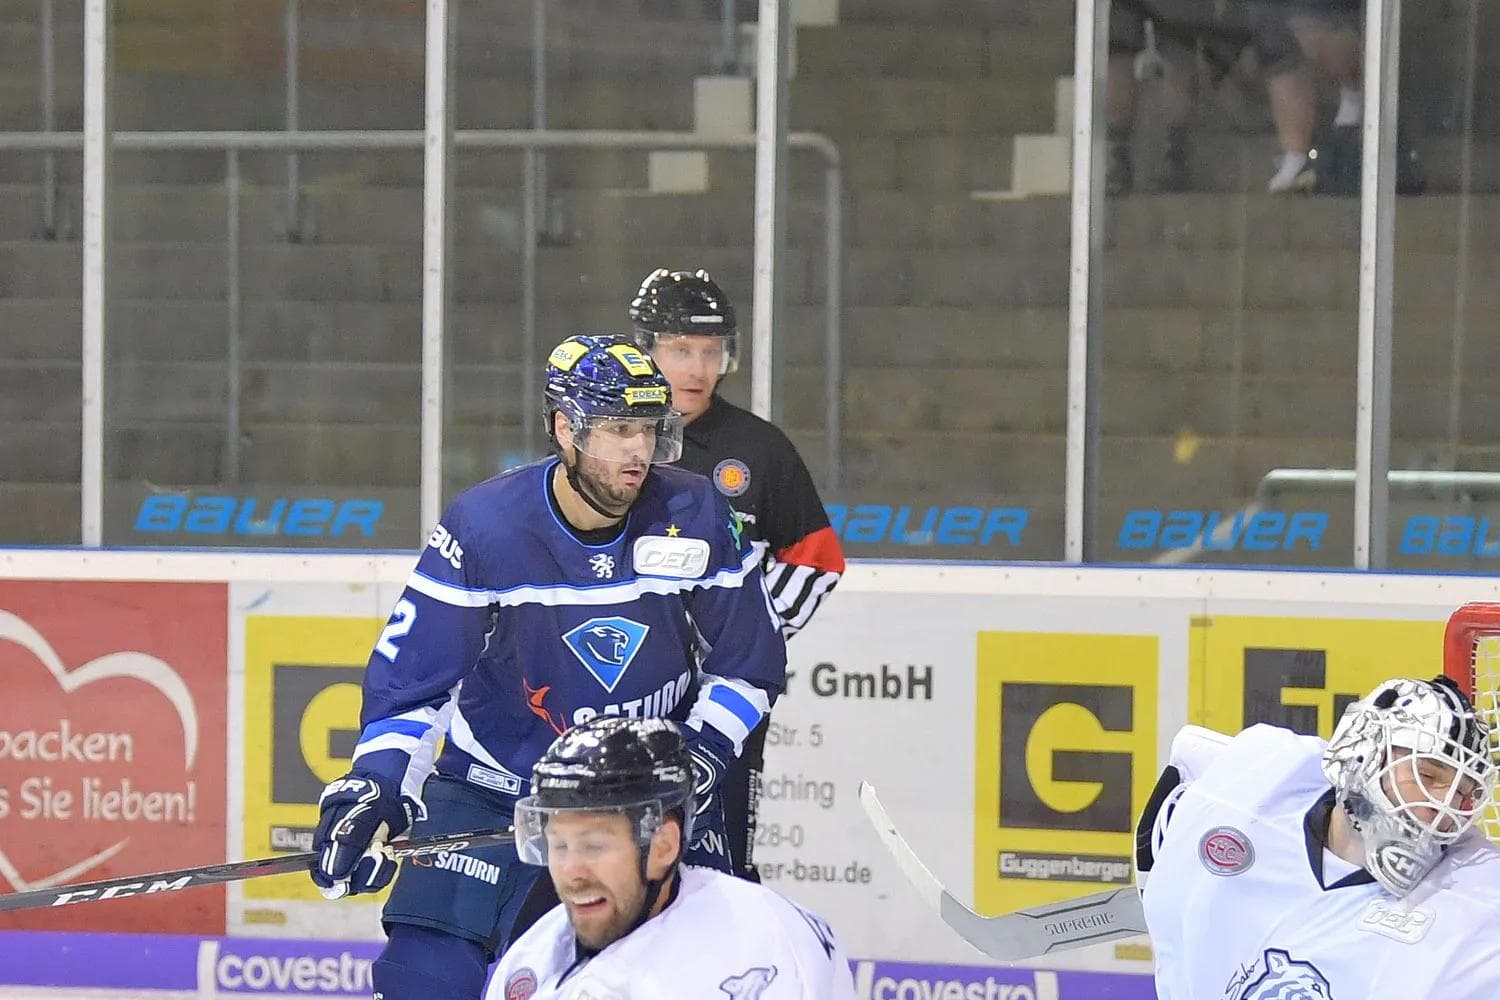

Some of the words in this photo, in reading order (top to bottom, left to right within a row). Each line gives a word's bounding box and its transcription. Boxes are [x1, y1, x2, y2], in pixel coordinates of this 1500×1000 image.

[134, 495, 385, 538] BAUER
[1117, 510, 1328, 550] BAUER
[811, 663, 933, 700] GmbH
[810, 723, 824, 747] 5
[20, 776, 73, 820] Sie
[82, 776, 197, 822] lieben!
[761, 773, 836, 809] ching
[435, 850, 501, 885] SATURN
[52, 876, 192, 907] CCM
[217, 951, 375, 992] covestr
